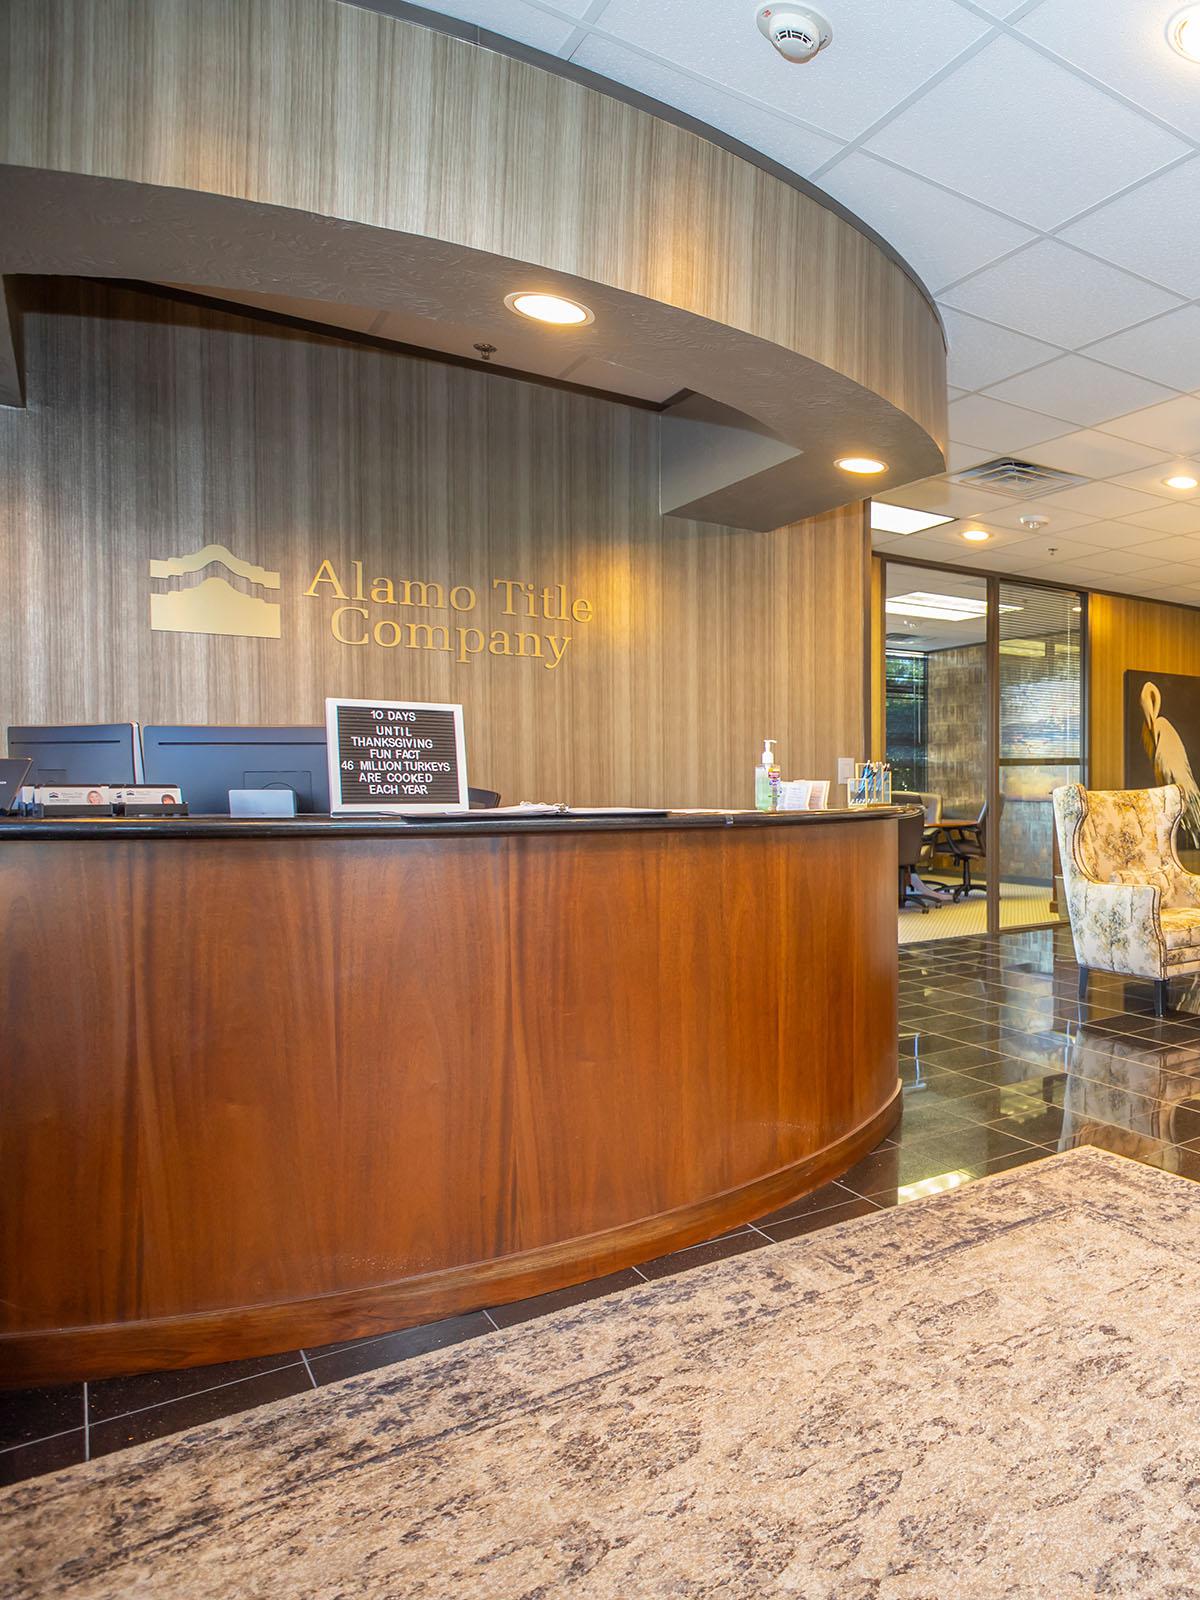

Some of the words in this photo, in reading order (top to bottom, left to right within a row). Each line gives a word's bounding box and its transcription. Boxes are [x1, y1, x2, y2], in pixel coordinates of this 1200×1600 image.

[303, 559, 477, 612] Alamo
[493, 578, 594, 623] Title
[330, 606, 573, 670] Company
[370, 710, 384, 720] 10
[388, 711, 417, 722] DAYS
[376, 725, 412, 737] UNTIL
[351, 736, 433, 749] THANKSGIVING
[370, 749, 391, 759] FUN
[395, 750, 420, 760] FACT
[341, 760, 354, 771] 46
[360, 761, 401, 771] MILLION
[403, 761, 451, 772] TURKEYS
[359, 772, 381, 783] ARE
[386, 773, 433, 783] COOKED
[369, 784, 399, 795] EACH
[402, 785, 429, 795] YEAR
